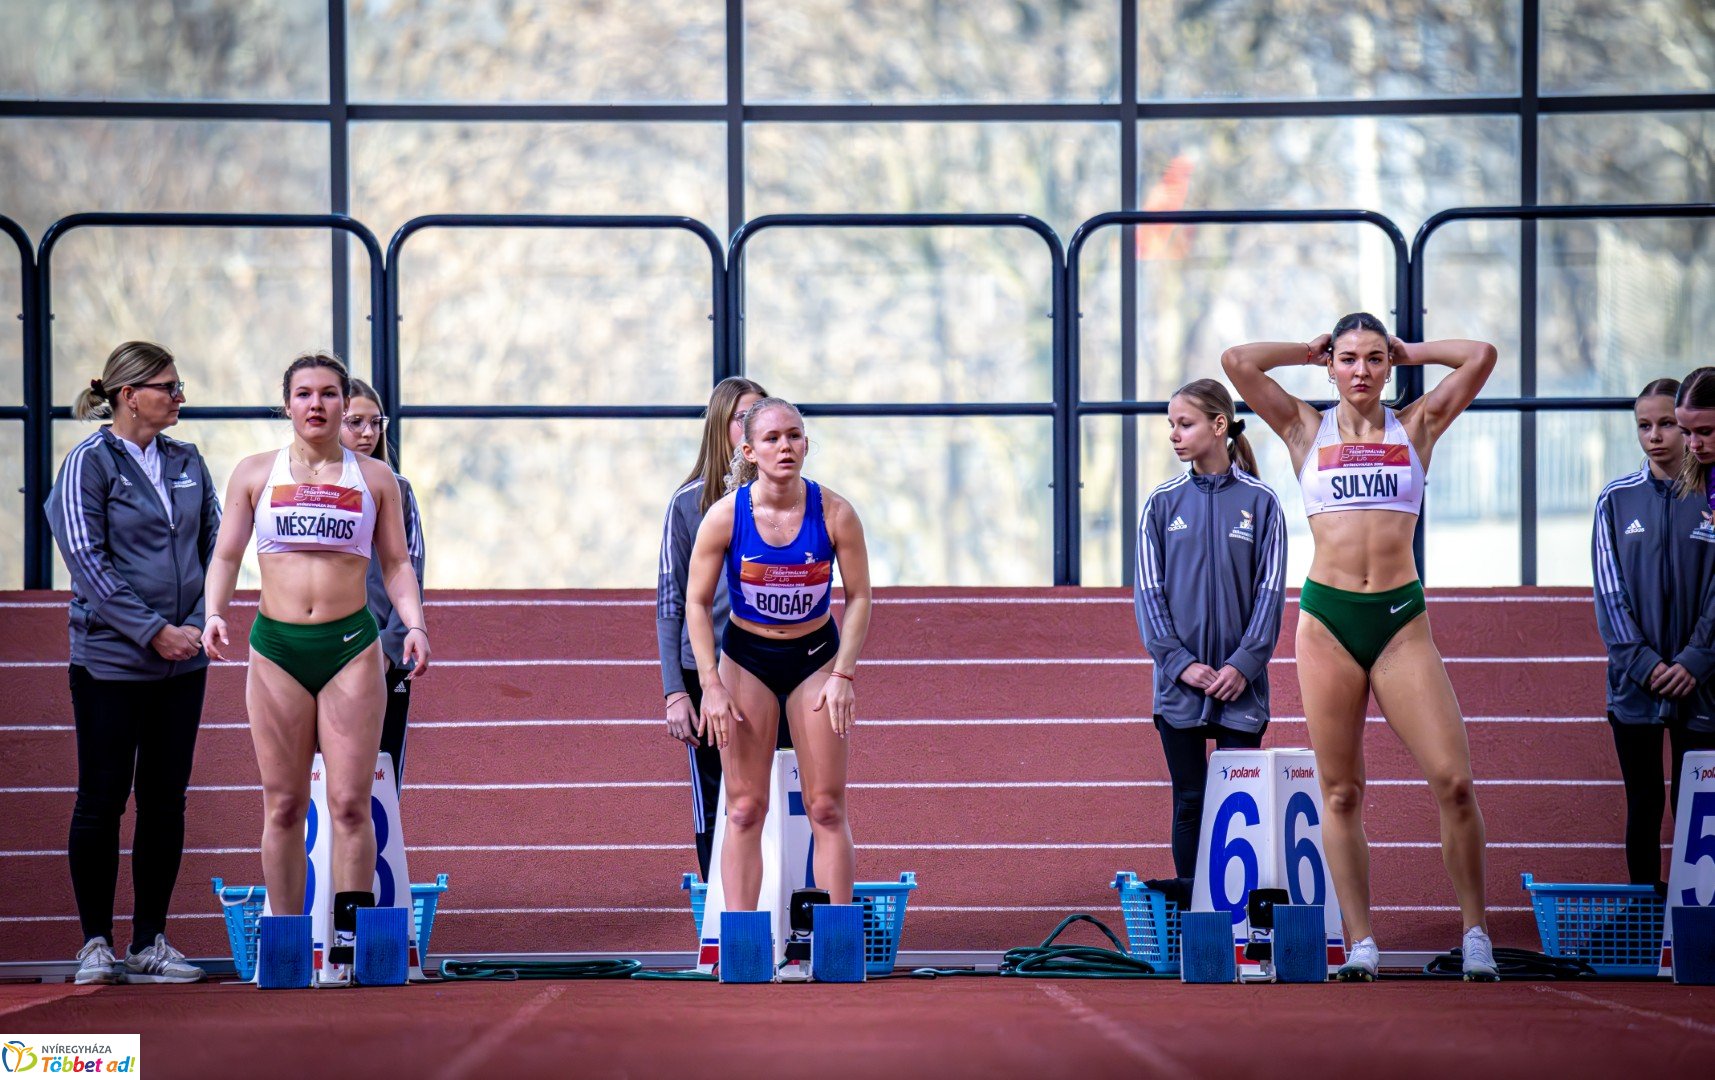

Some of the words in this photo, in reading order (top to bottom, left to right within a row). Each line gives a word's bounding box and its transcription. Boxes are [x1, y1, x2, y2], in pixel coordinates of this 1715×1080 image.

[1331, 469, 1398, 500] SULYÁN
[276, 512, 355, 540] MÉSZÁROS
[756, 590, 813, 615] BOGÁR
[1230, 766, 1261, 781] polanik
[1291, 766, 1315, 781] polanik
[1209, 791, 1260, 925] 6
[1285, 791, 1326, 905] 6
[1681, 792, 1715, 906] 5
